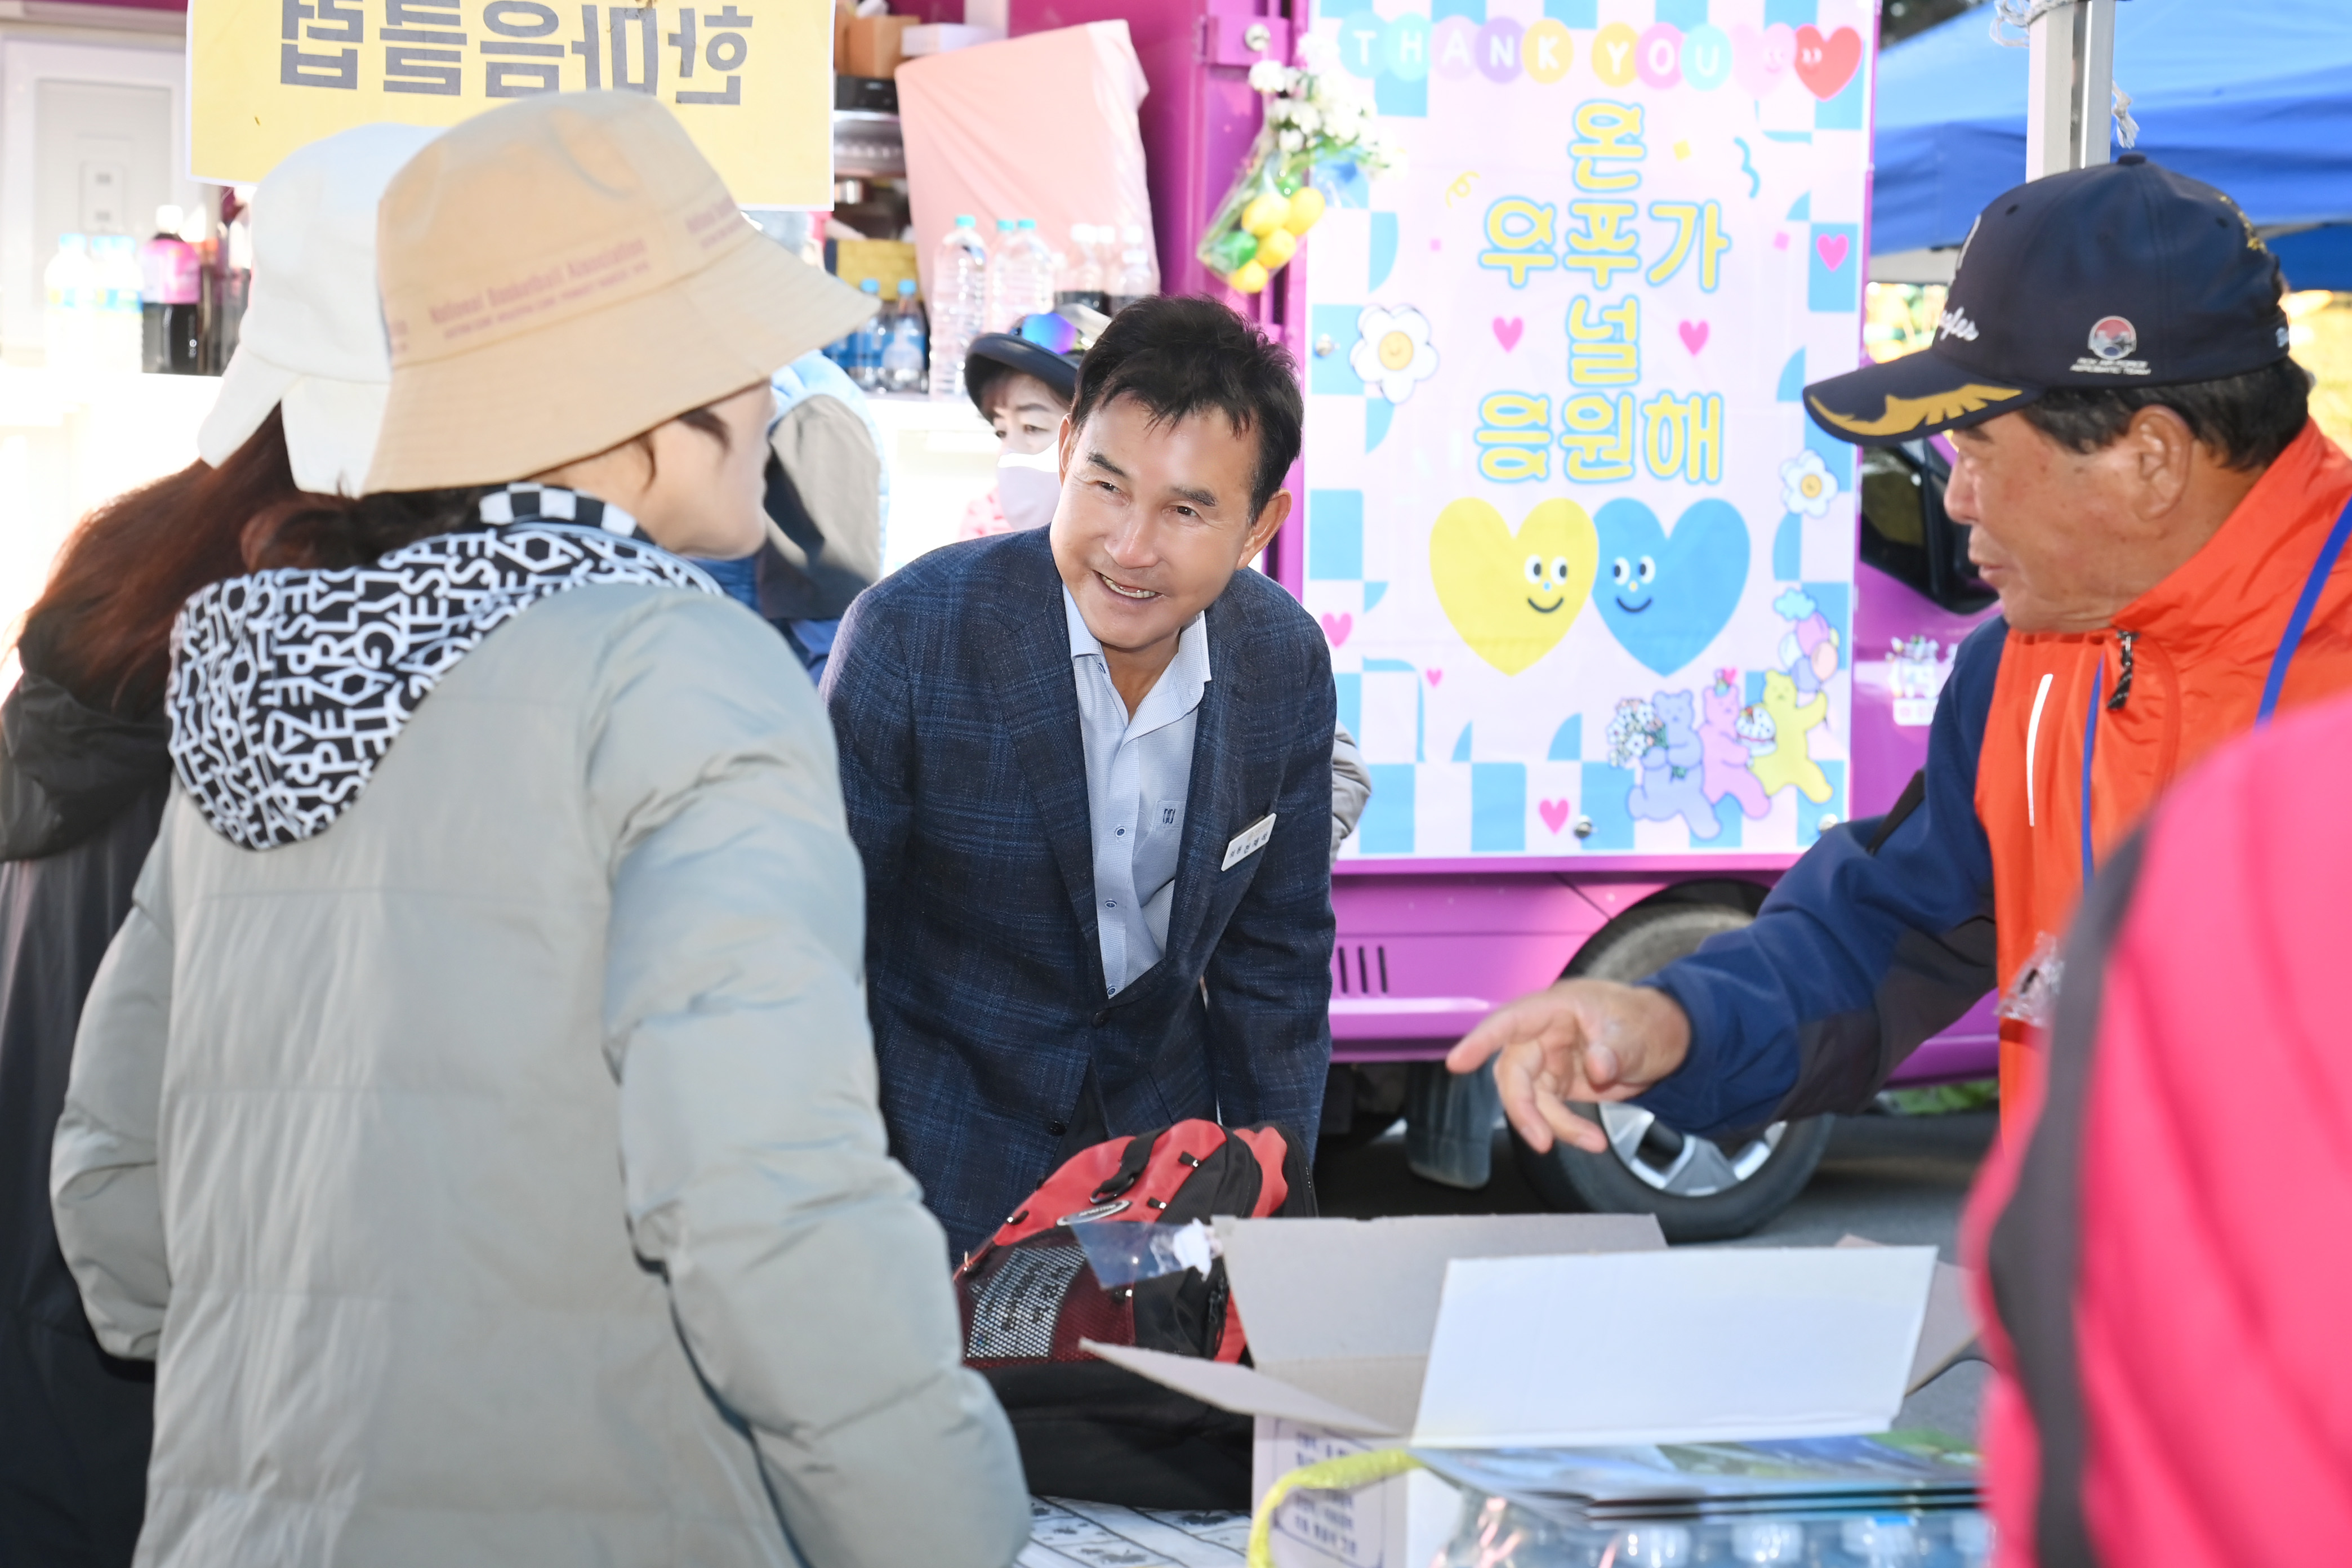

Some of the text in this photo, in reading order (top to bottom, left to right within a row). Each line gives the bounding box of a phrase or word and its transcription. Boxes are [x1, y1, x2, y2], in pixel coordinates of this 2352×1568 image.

[1353, 29, 1719, 77] THANK YOU
[1570, 101, 1645, 191] 온
[1569, 296, 1639, 386] 널
[1475, 391, 1722, 484] 응원해
